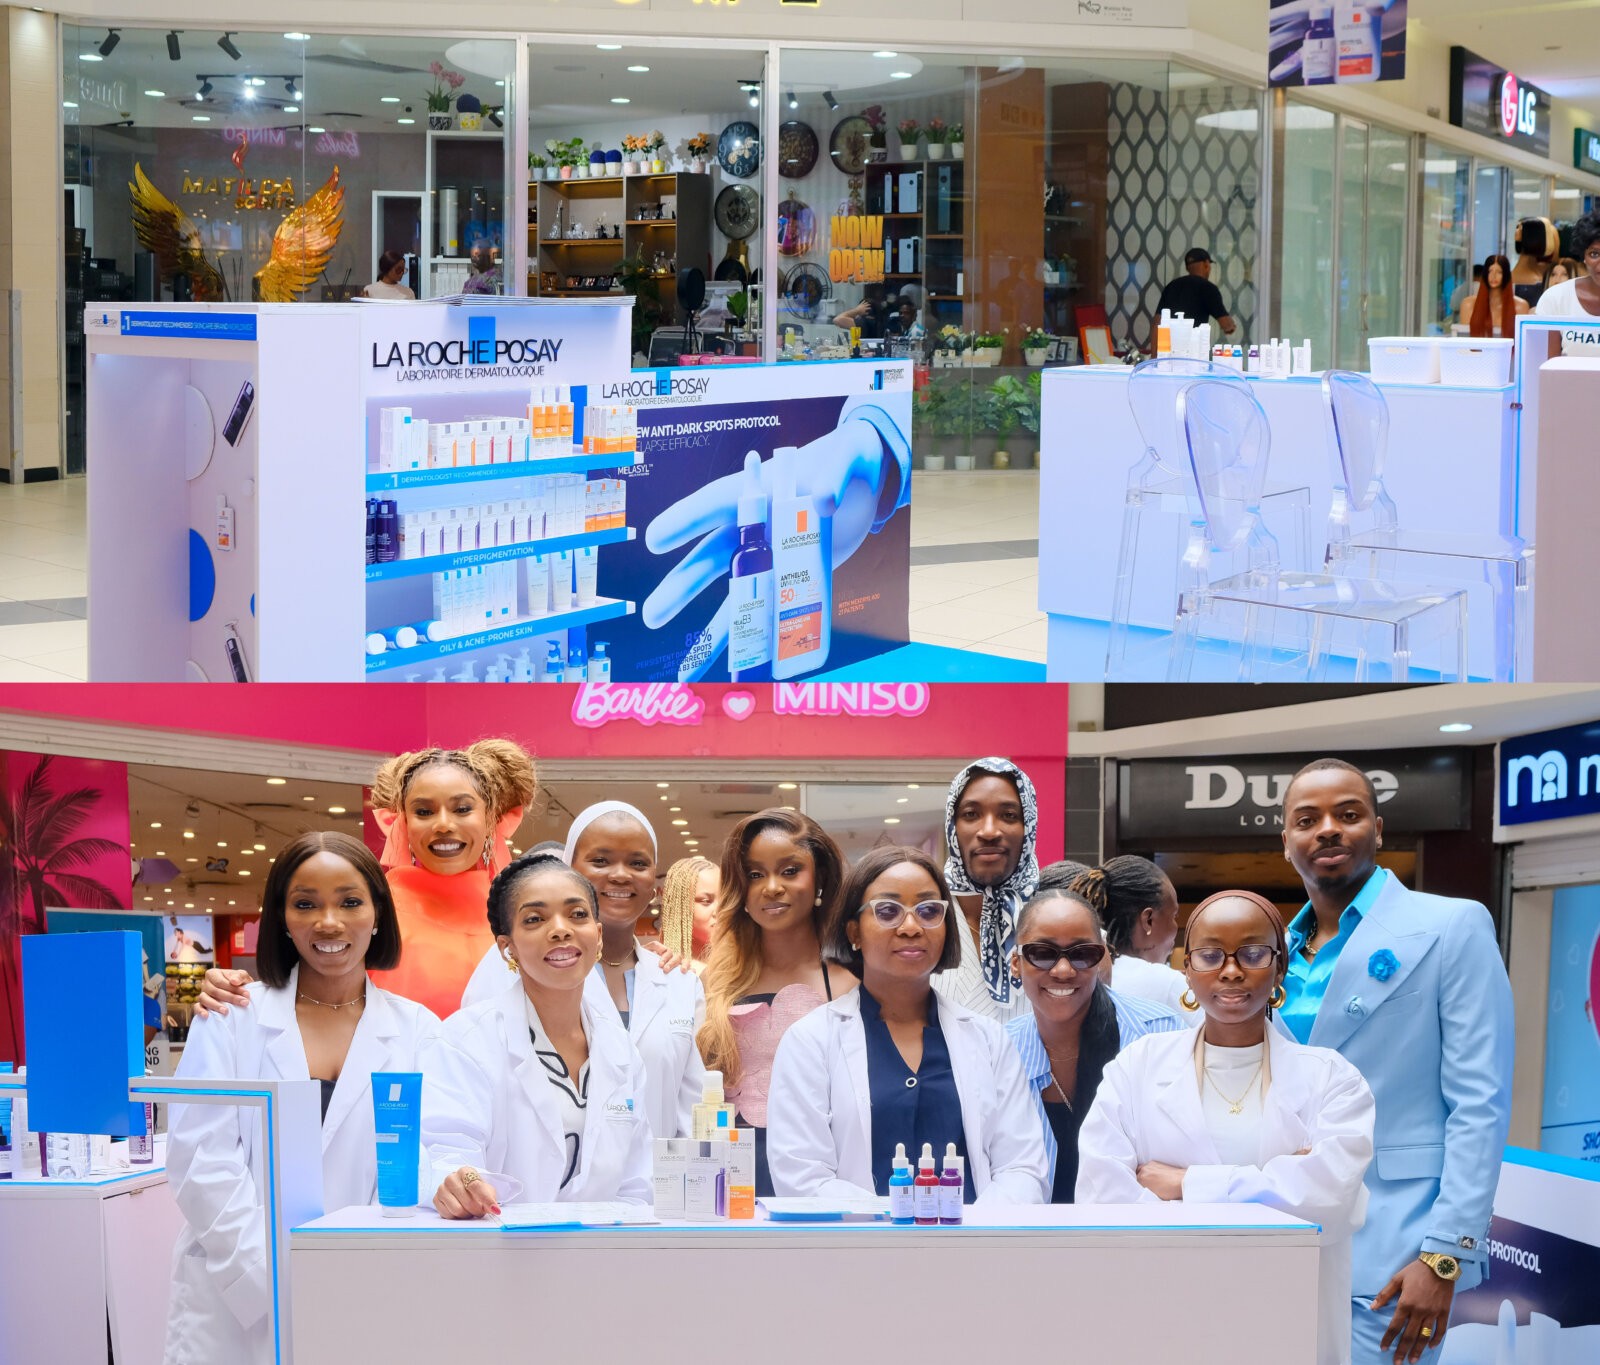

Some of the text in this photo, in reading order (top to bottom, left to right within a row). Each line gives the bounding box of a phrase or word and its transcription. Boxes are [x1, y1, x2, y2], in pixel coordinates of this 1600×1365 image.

[1517, 87, 1536, 136] LG
[182, 176, 295, 196] MATILDA
[831, 215, 884, 249] NOW
[372, 338, 563, 368] LA ROCHE POSAY
[396, 364, 544, 382] LABORATOIRE DERMATOLOGIQUE
[602, 377, 710, 398] LA ROCHE POSAY
[625, 395, 658, 406] ABORATOIRE
[636, 415, 781, 438] EW ANTI-DARK SPOTS PROTOCOL
[401, 473, 453, 484] DERMATOLOGIST
[453, 468, 498, 479] RECOMMENDED
[453, 546, 534, 565] HYPERPIGMENTATION
[781, 570, 809, 581] ANTHELIOS
[439, 625, 533, 653] OILY & ACNE-PRONE SKIN
[685, 628, 712, 647] 85%
[692, 643, 712, 654] SPOTS
[676, 651, 712, 666] CORRECTED
[682, 664, 690, 672] B3
[576, 683, 925, 722] Barbie MINISO
[1185, 765, 1399, 810] Due
[1240, 815, 1284, 826] LON
[145, 1047, 159, 1056] NG
[145, 1056, 160, 1065] ND
[1490, 1240, 1541, 1274] PROTOCOL
